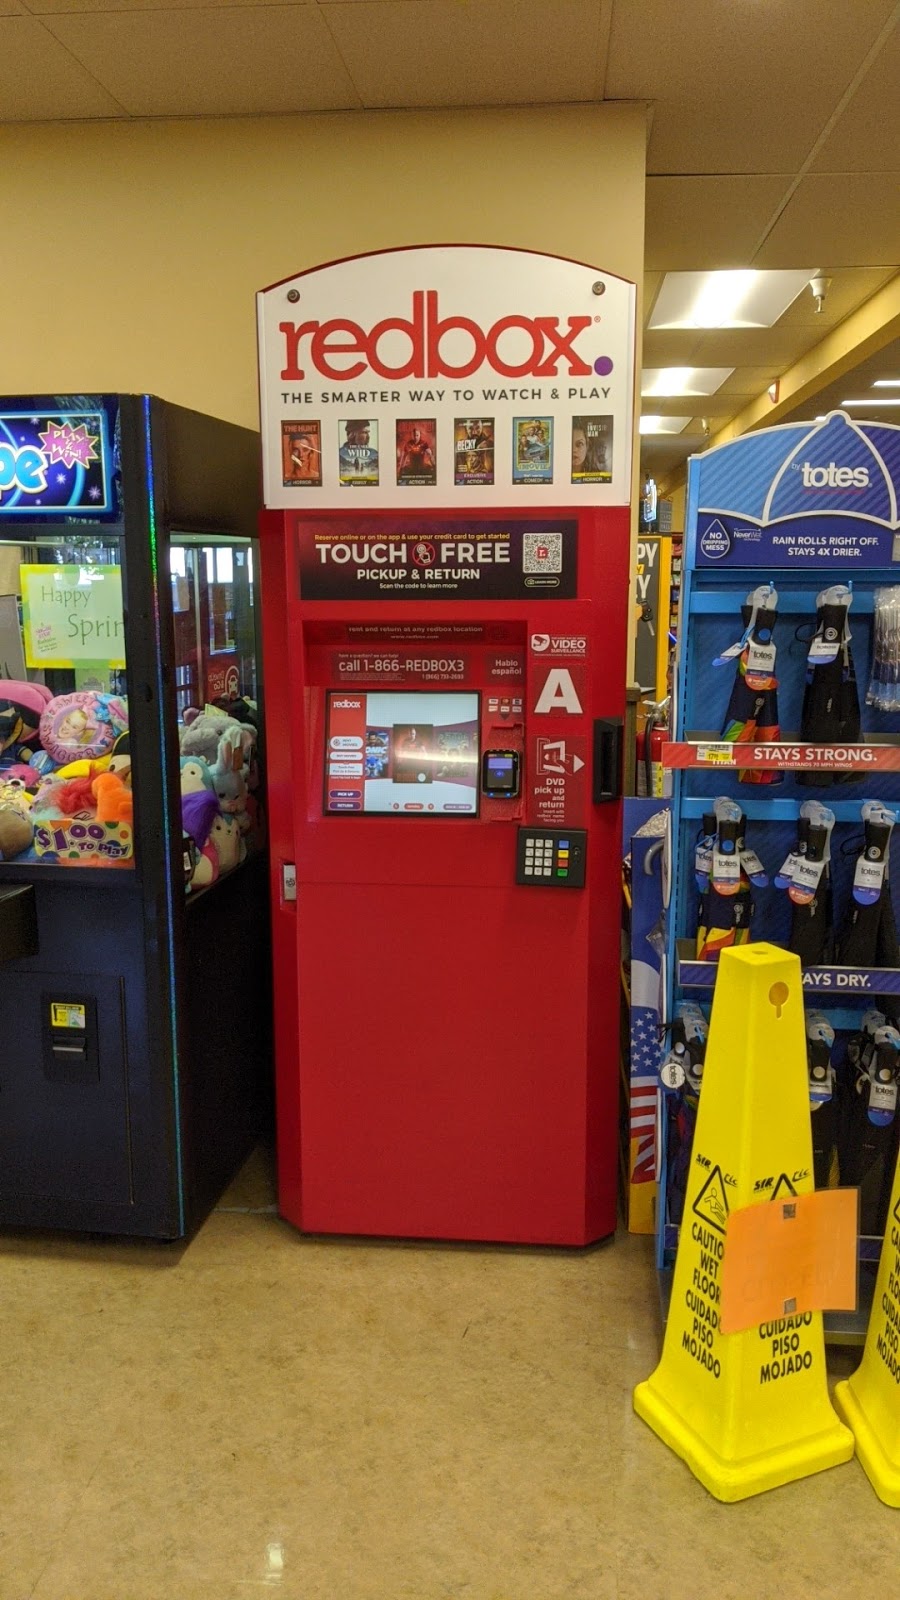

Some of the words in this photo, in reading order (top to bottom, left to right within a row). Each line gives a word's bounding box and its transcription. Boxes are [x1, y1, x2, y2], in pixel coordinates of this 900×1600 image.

[281, 392, 313, 404] THE
[321, 391, 401, 403] SMARTER
[408, 390, 445, 402] WAY
[453, 389, 474, 401] TO
[482, 388, 542, 400] WATCH
[550, 388, 560, 399] &
[568, 387, 611, 399] PLAY
[53, 429, 85, 444] PLAY
[457, 438, 476, 451] BECKY
[348, 449, 371, 458] WILD
[791, 463, 801, 471] by
[802, 462, 869, 488] totes
[476, 533, 485, 541] get
[773, 536, 795, 545] RAIN
[798, 536, 826, 545] ROLLS
[829, 537, 857, 545] RIGHT
[859, 537, 879, 546] OFF.
[315, 543, 407, 564] TOUCH
[441, 542, 510, 563] FREE
[788, 547, 815, 556] STAYS
[817, 547, 830, 556] 4X
[832, 548, 862, 556] DRIER.
[356, 569, 407, 580] PICKUP
[411, 569, 420, 580] &
[424, 568, 480, 580] RETURN
[41, 586, 91, 608] Happy
[551, 640, 586, 648] VIDEO
[754, 651, 772, 660] totes
[339, 660, 360, 671] call
[363, 660, 464, 672] 1-866-REDBOX3
[495, 659, 518, 667] Hablo
[491, 666, 522, 675] español
[534, 668, 583, 713] A
[333, 699, 361, 708] redbox
[754, 747, 801, 760] STAYS
[805, 748, 878, 761] STRONG.
[534, 786, 552, 794] pick
[800, 865, 818, 877] totes
[861, 867, 880, 876] totes
[801, 973, 832, 986] AYS
[836, 974, 872, 987] DRY.
[875, 1086, 893, 1096] totes
[692, 1222, 724, 1260] CAUTIO
[700, 1250, 719, 1279] WET
[686, 1290, 721, 1330] CUIDAD
[759, 1310, 812, 1340] CUIDADO
[693, 1317, 714, 1349] PISO
[885, 1321, 898, 1353] PISO
[772, 1333, 800, 1358] PISO
[682, 1331, 721, 1379] MOJADO
[760, 1351, 812, 1384] MOJADO
